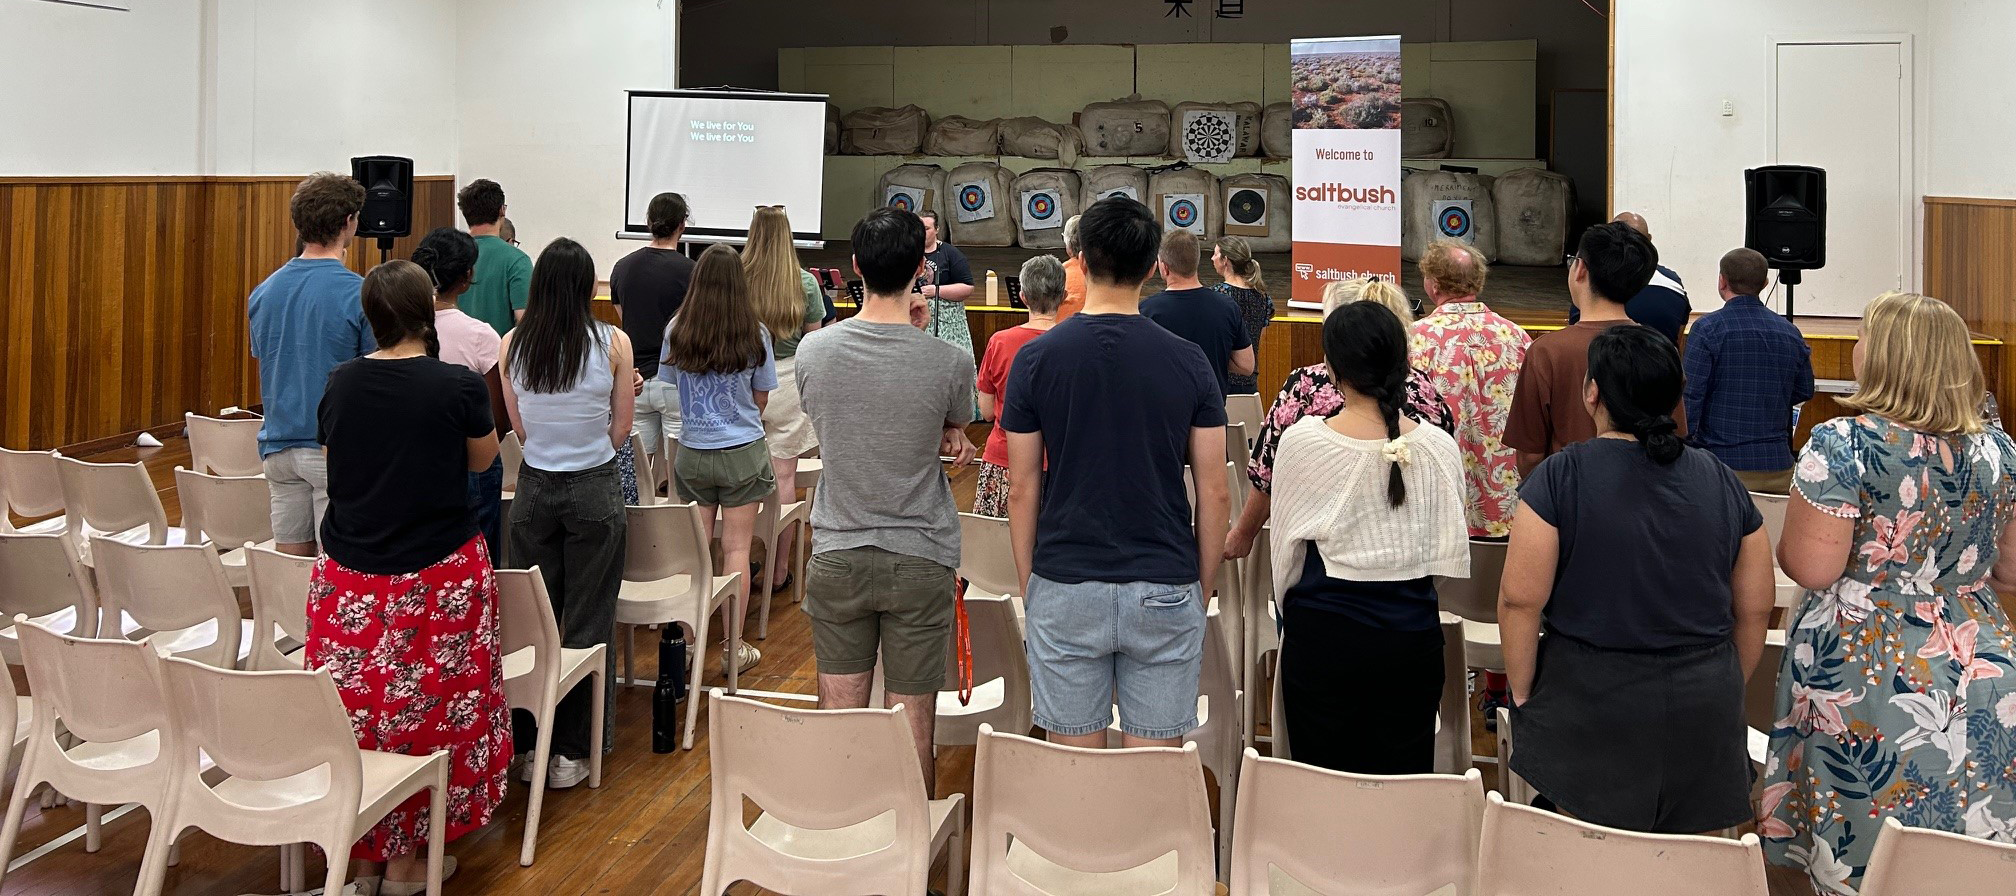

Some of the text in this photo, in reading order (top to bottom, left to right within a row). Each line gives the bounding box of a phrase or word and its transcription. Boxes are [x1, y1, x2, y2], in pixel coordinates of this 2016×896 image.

[690, 120, 754, 131] We live for You
[1135, 122, 1143, 133] 5
[1425, 118, 1433, 126] 10
[690, 132, 754, 143] We live for You
[1315, 148, 1374, 161] Welcome to
[1295, 182, 1395, 204] saltbush
